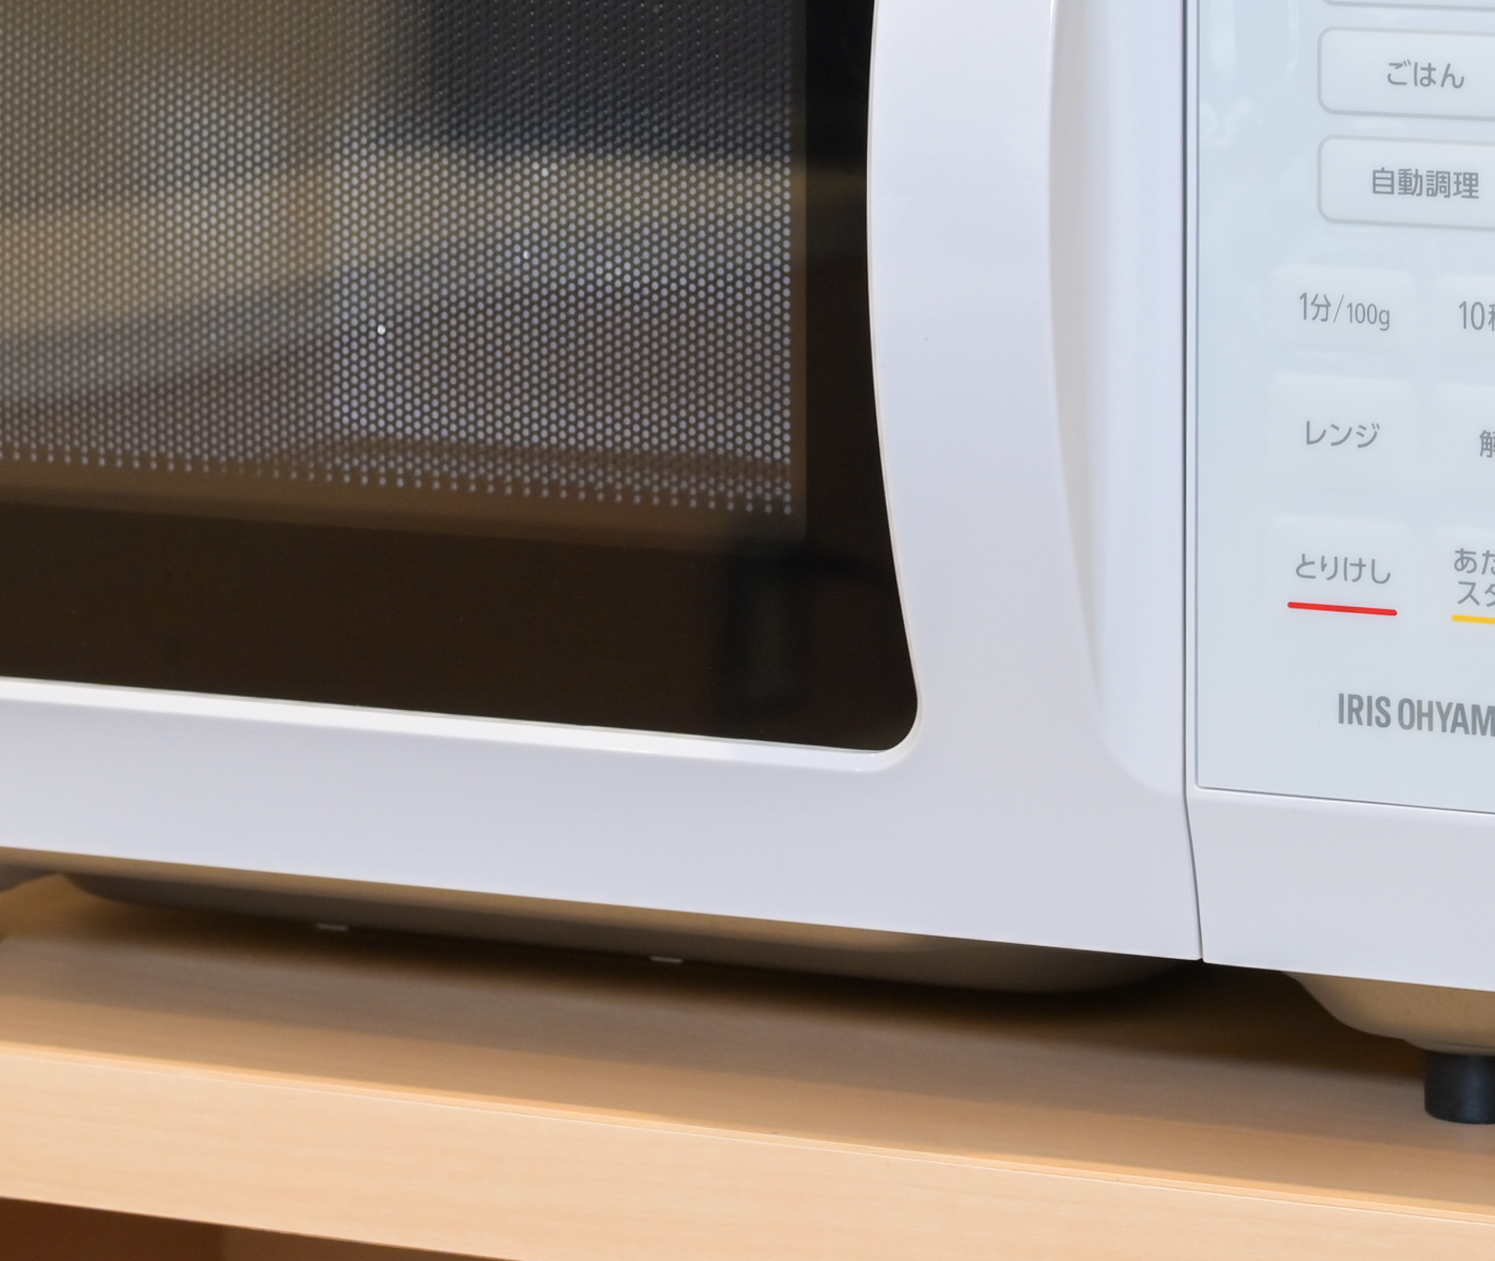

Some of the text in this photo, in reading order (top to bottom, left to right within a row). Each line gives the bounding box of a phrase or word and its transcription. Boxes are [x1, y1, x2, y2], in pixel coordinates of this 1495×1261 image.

[1385, 59, 1466, 90] ごはん
[1371, 165, 1481, 200] 自動調理
[1298, 292, 1391, 332] 1分/100g
[1304, 420, 1382, 450] レンジ
[1294, 552, 1392, 586] とりけし
[1337, 691, 1392, 729] IRIS
